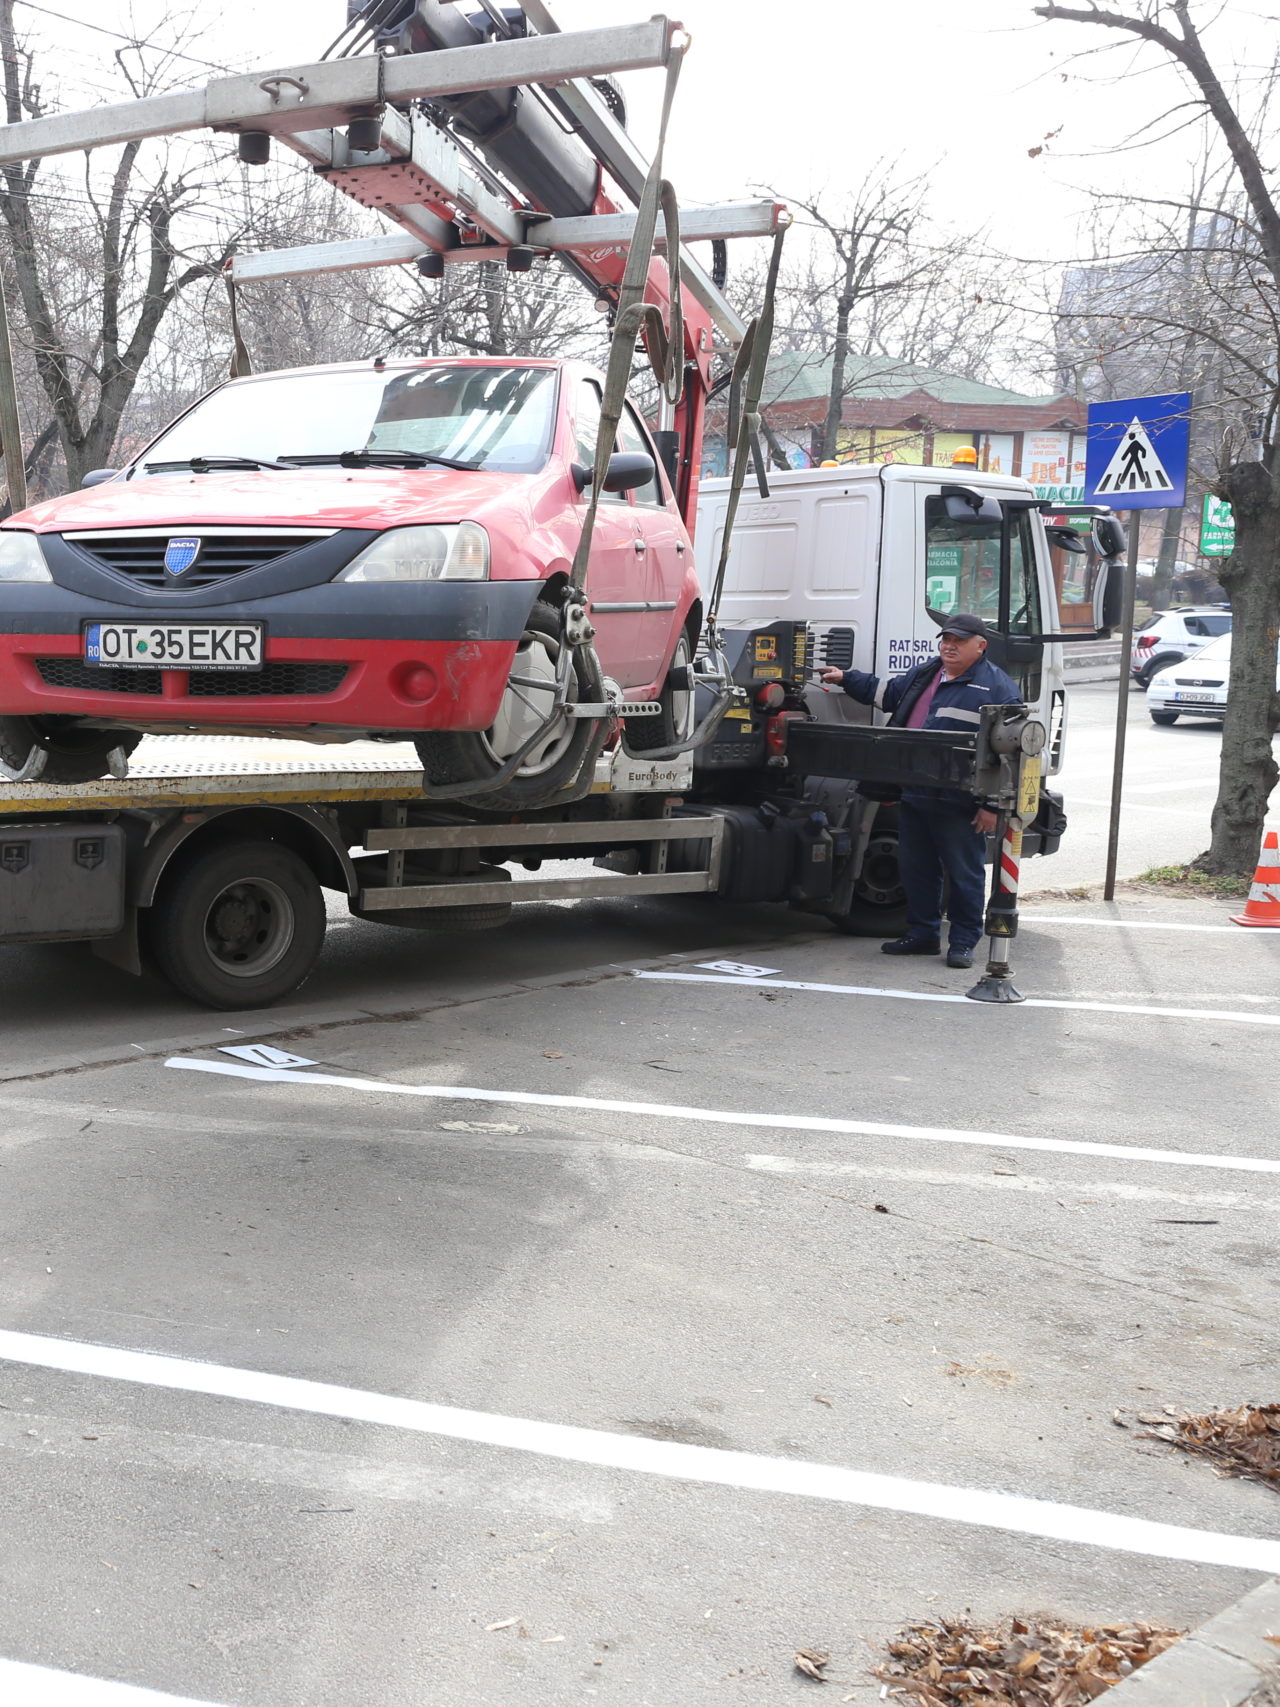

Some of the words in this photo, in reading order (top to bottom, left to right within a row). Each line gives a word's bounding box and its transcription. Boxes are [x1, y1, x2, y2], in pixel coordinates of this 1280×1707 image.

[103, 629, 137, 658] OT
[150, 629, 183, 660] 35
[189, 630, 256, 660] EKR
[889, 640, 911, 652] RAT
[913, 640, 934, 652] SRL
[88, 645, 99, 657] RO
[629, 772, 678, 782] EuroBody
